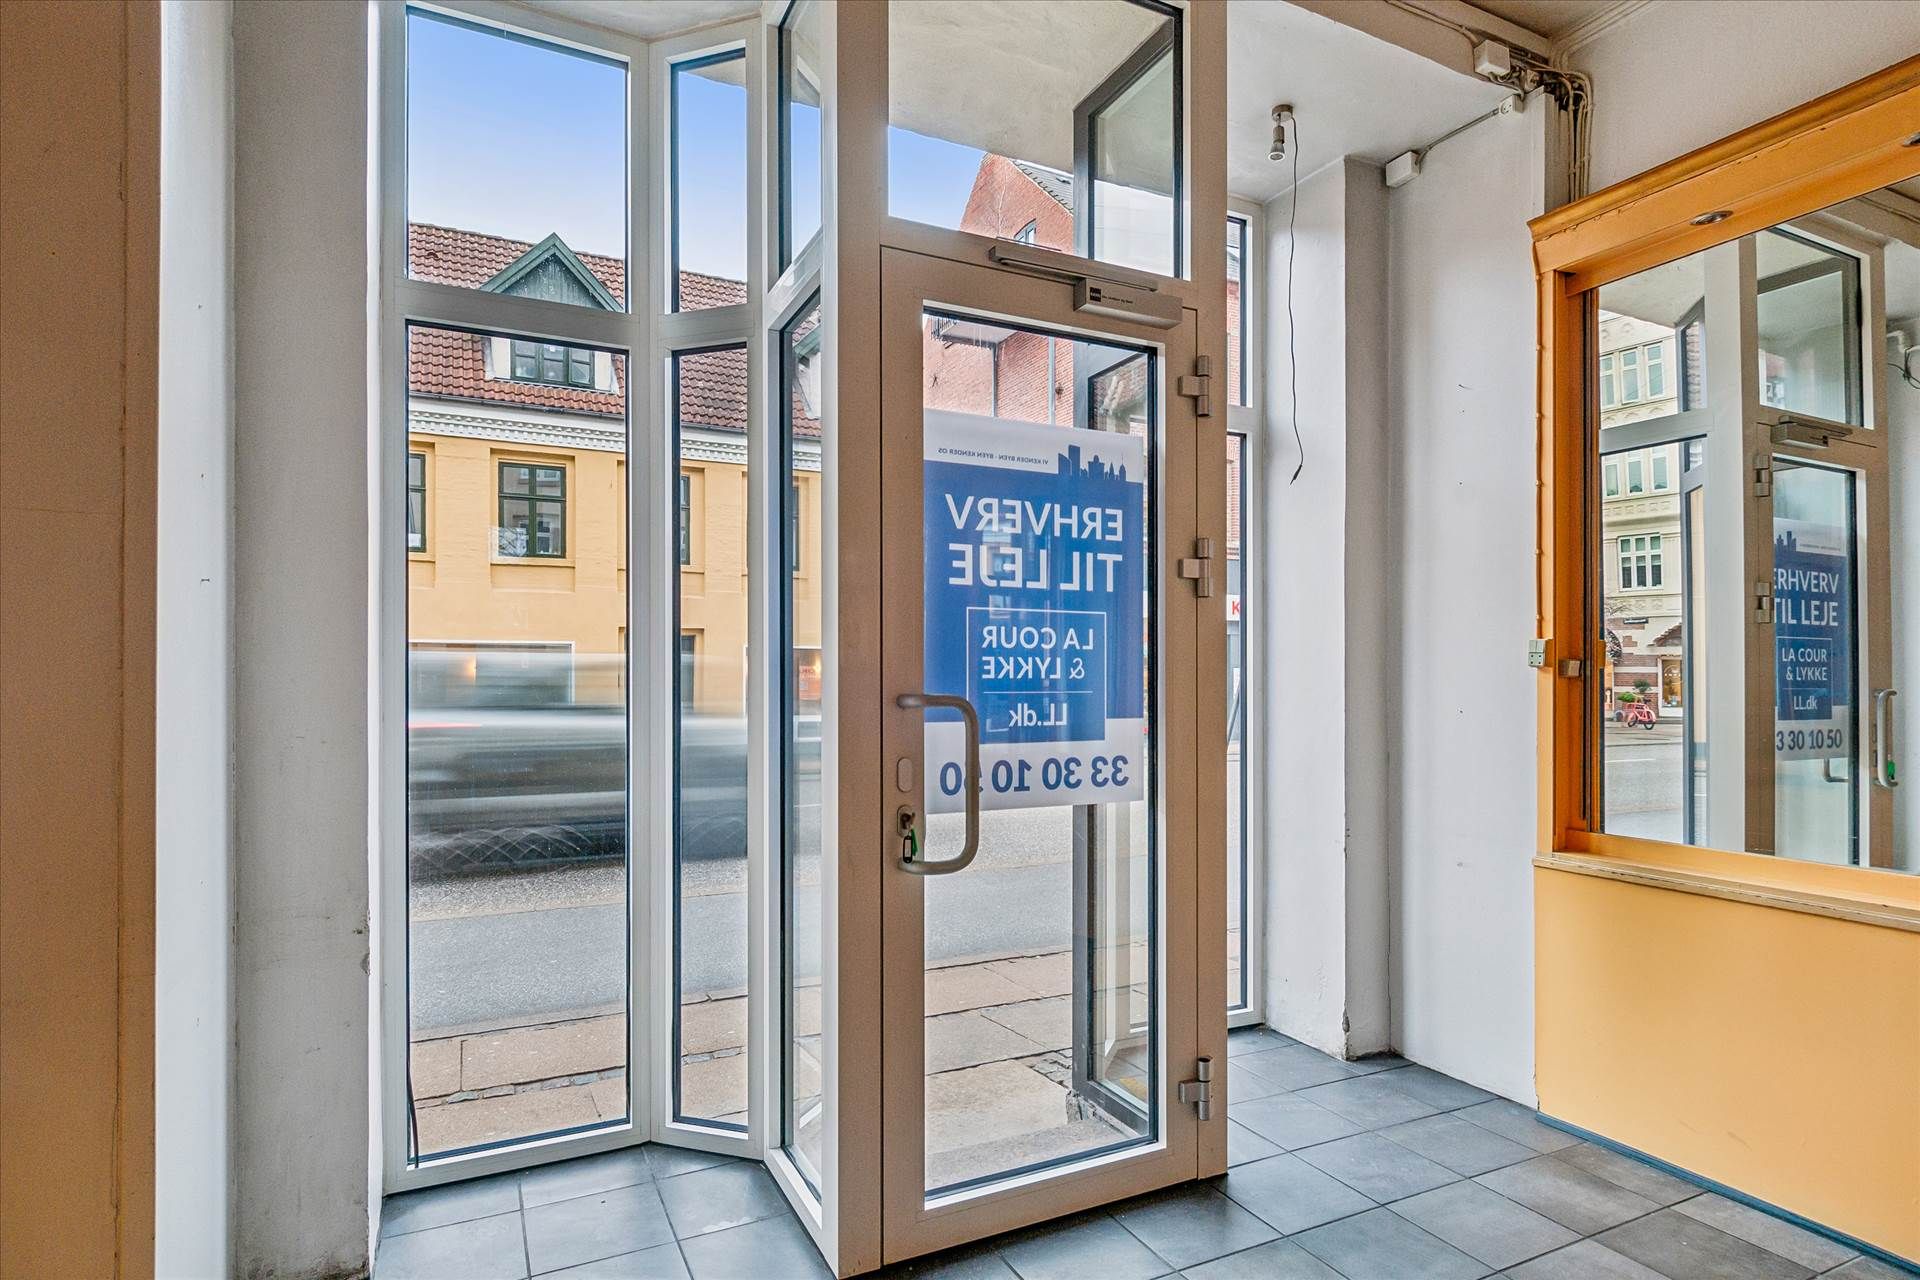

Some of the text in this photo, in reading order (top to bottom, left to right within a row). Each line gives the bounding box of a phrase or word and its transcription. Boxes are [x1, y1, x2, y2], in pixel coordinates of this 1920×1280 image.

[1801, 599, 1839, 627] LEJE
[1781, 647, 1828, 662] LA COUR
[1785, 666, 1828, 681] & LYKKE
[1793, 695, 1818, 711] LL.dk
[1787, 730, 1805, 750] 30
[1808, 728, 1824, 750] 10
[1826, 728, 1842, 749] 50
